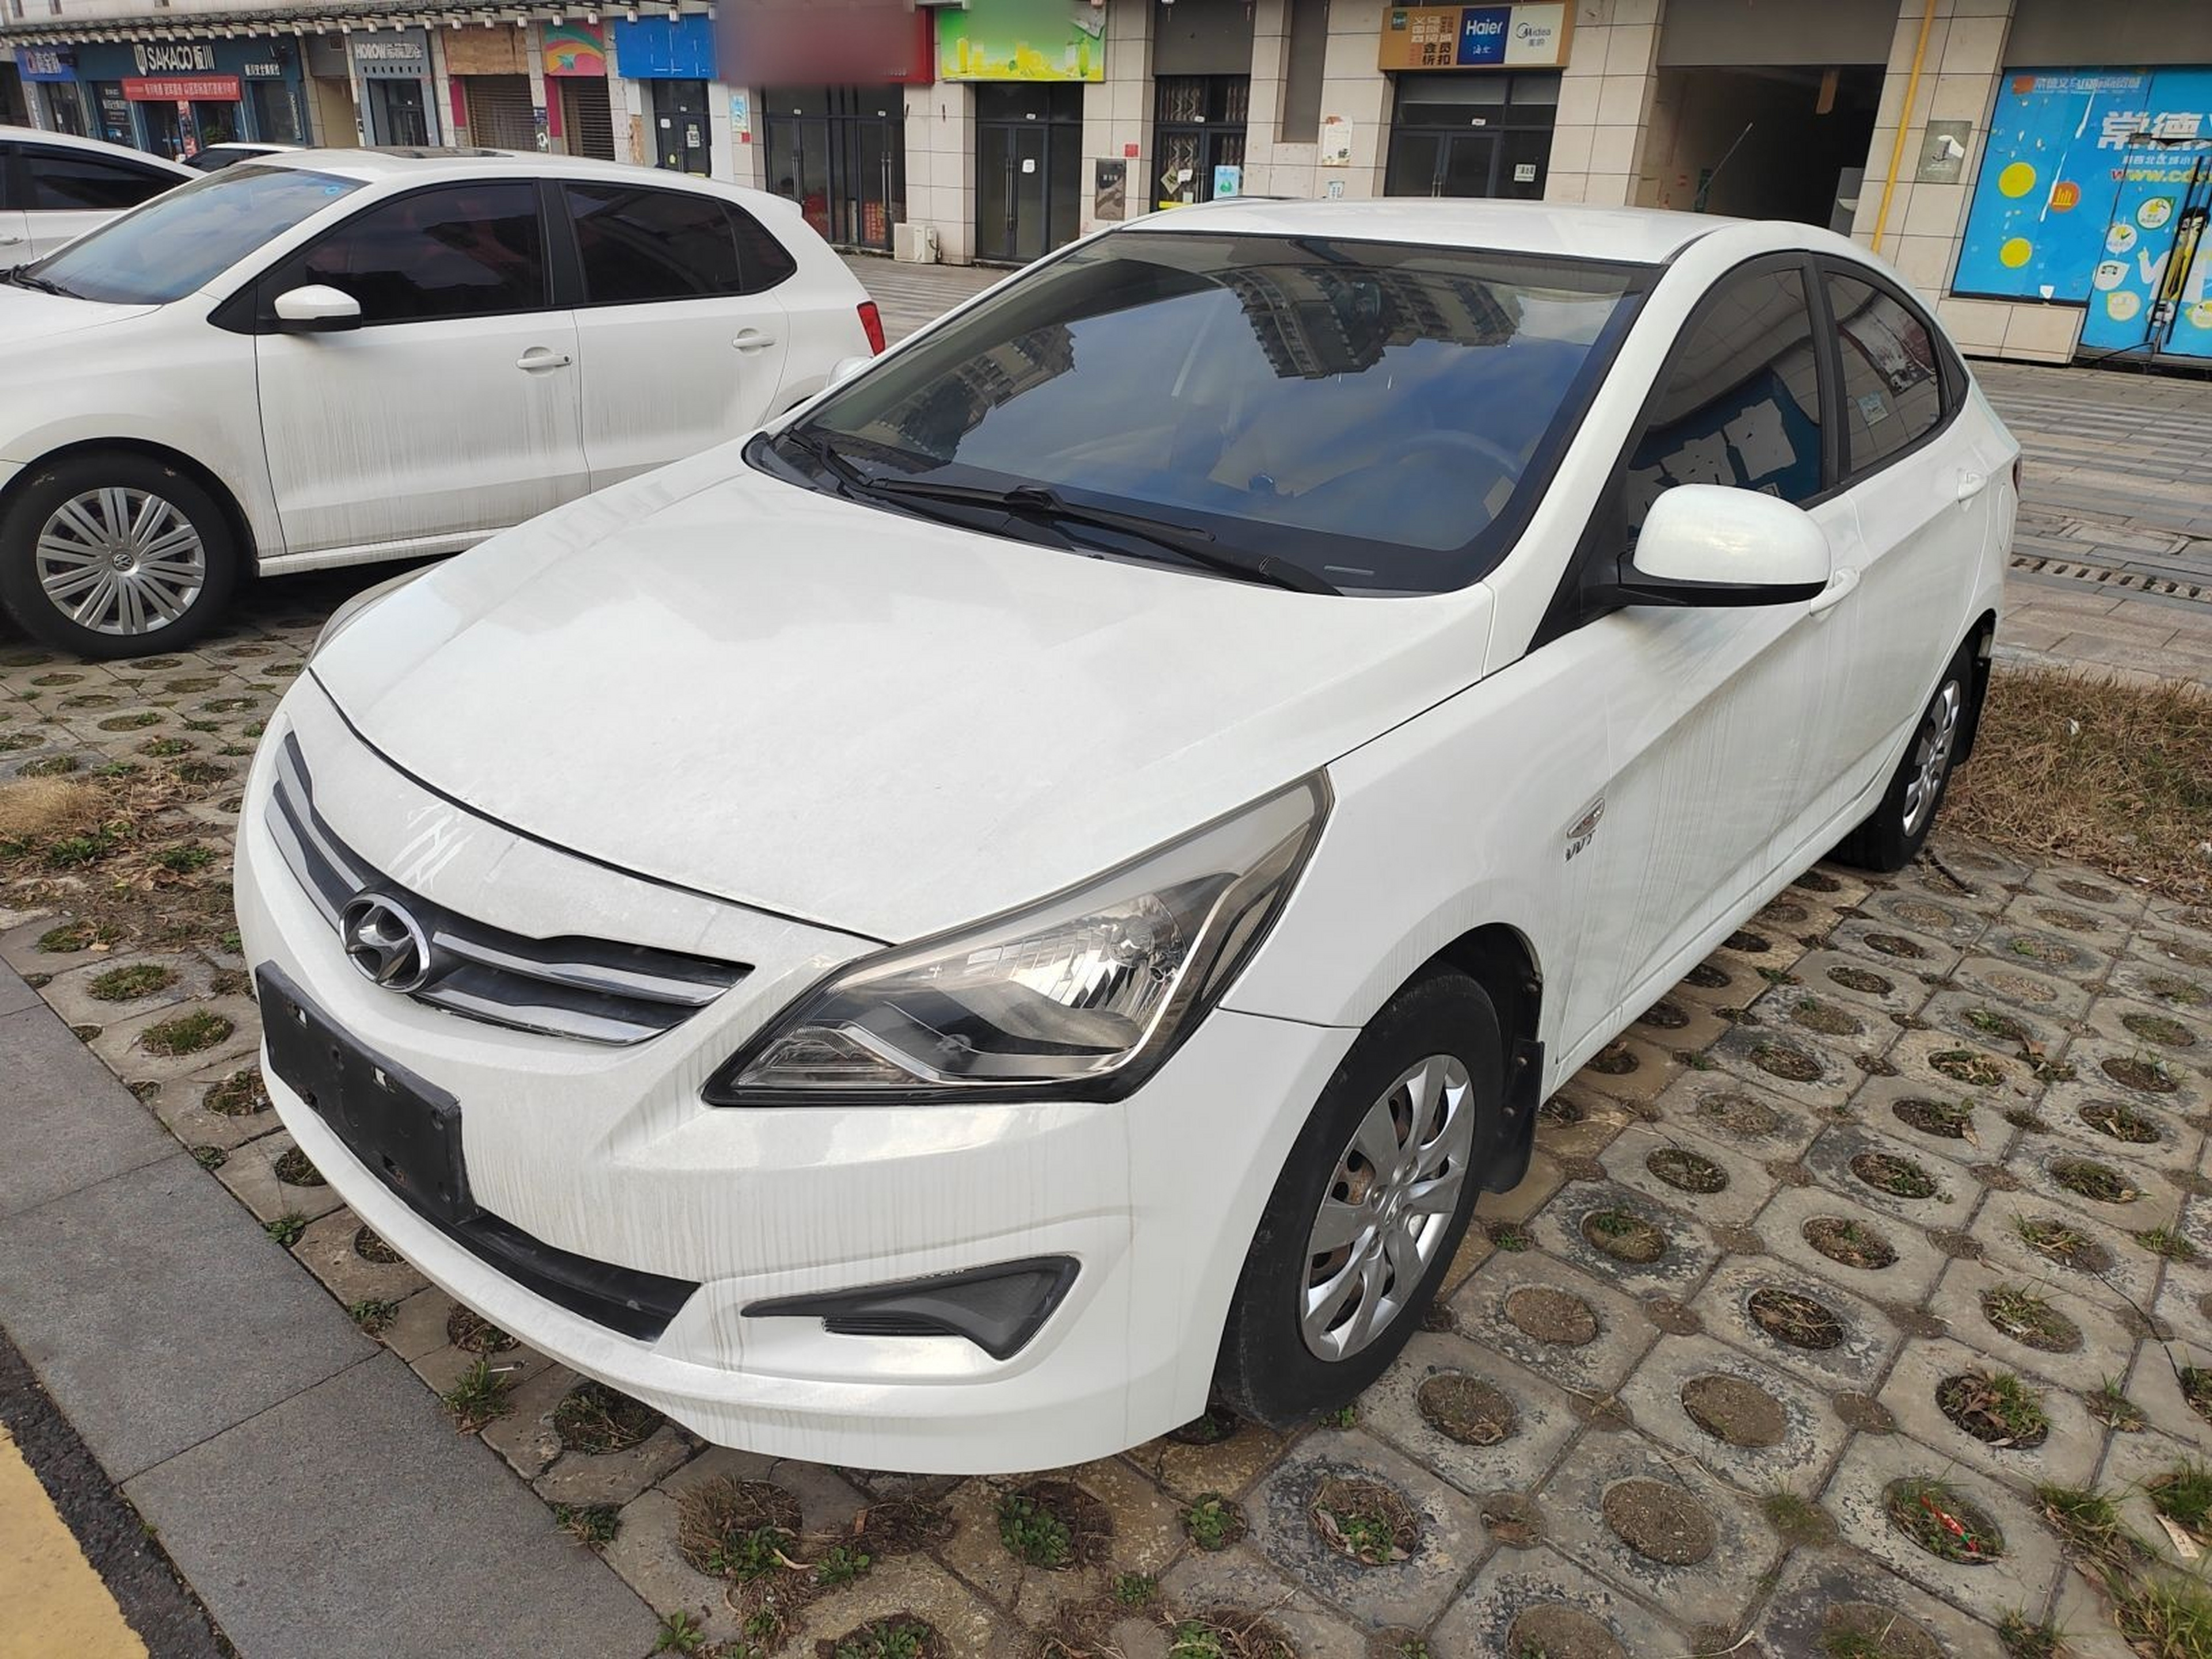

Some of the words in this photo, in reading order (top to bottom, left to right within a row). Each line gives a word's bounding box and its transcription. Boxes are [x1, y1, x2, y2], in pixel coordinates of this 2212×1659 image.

[1465, 18, 1503, 36] Haier
[147, 46, 193, 70] SAKACO
[1422, 54, 1451, 65] 折扣
[1565, 829, 1596, 862] VVT
